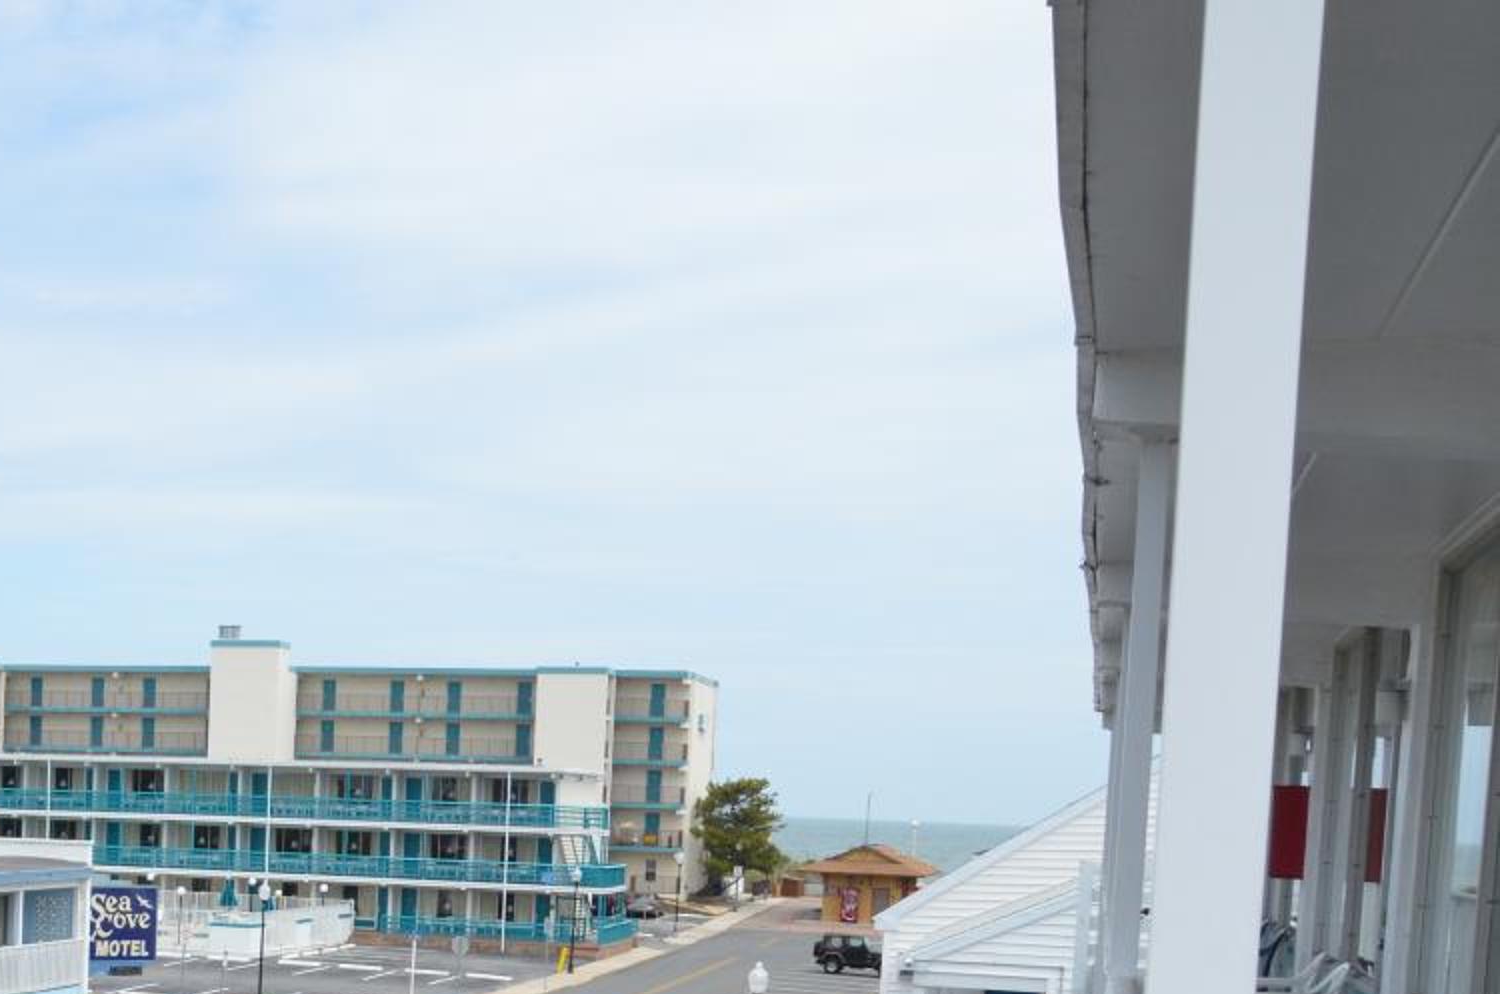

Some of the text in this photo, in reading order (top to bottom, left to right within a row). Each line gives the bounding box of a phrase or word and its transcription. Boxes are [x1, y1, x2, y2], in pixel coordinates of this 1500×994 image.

[91, 893, 132, 920] Sea
[95, 911, 151, 938] Cove
[95, 940, 149, 957] MOTEL
